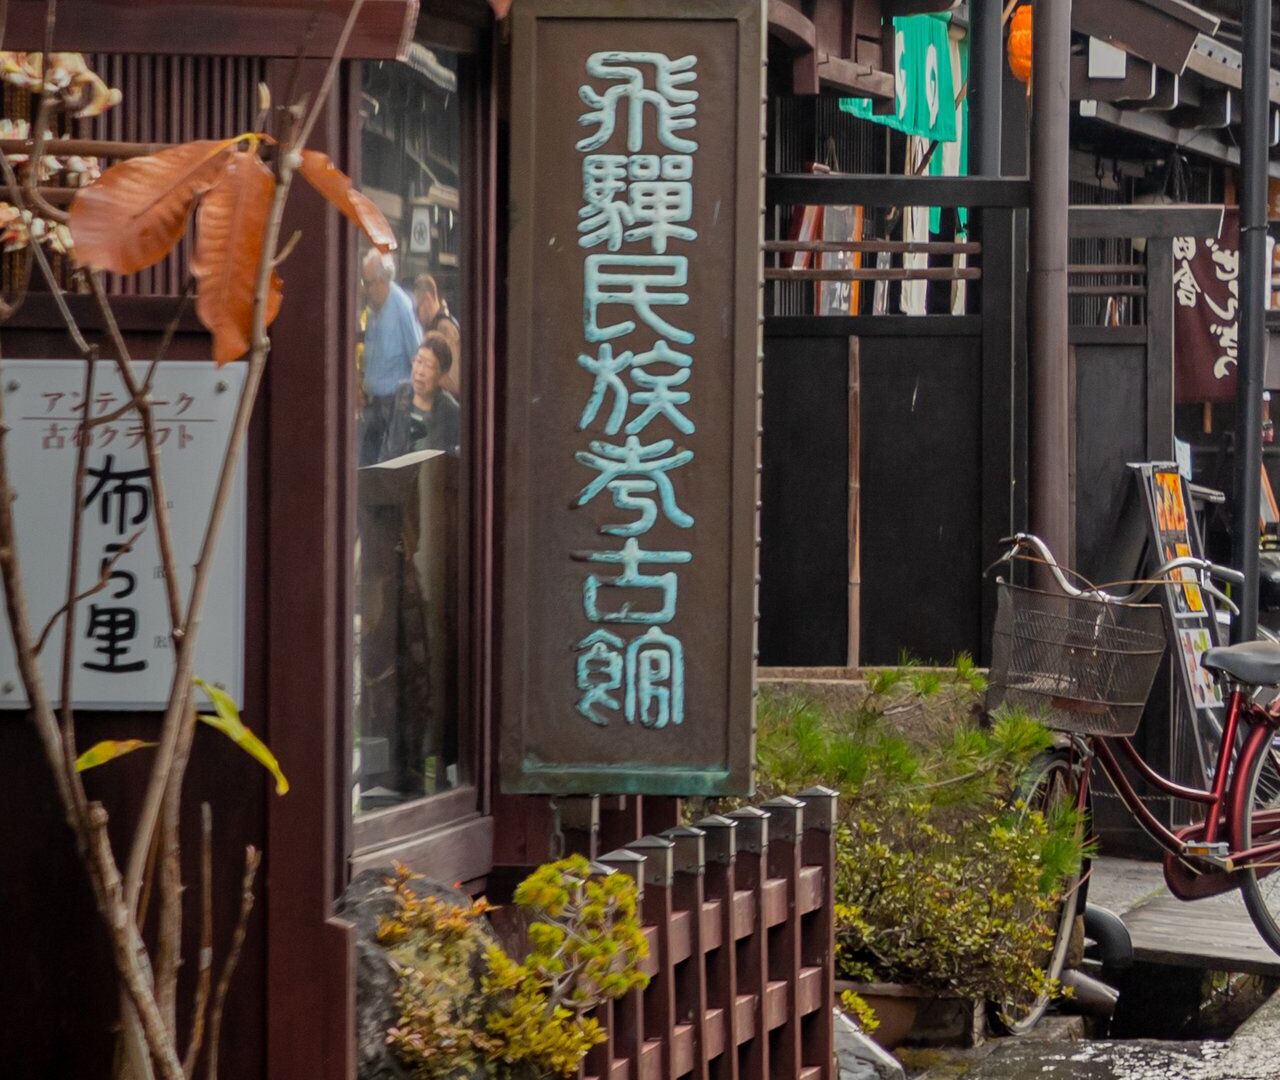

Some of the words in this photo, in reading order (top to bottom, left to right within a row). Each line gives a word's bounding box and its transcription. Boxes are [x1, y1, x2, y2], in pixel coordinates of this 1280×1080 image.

[41, 391, 195, 417] アンテーク
